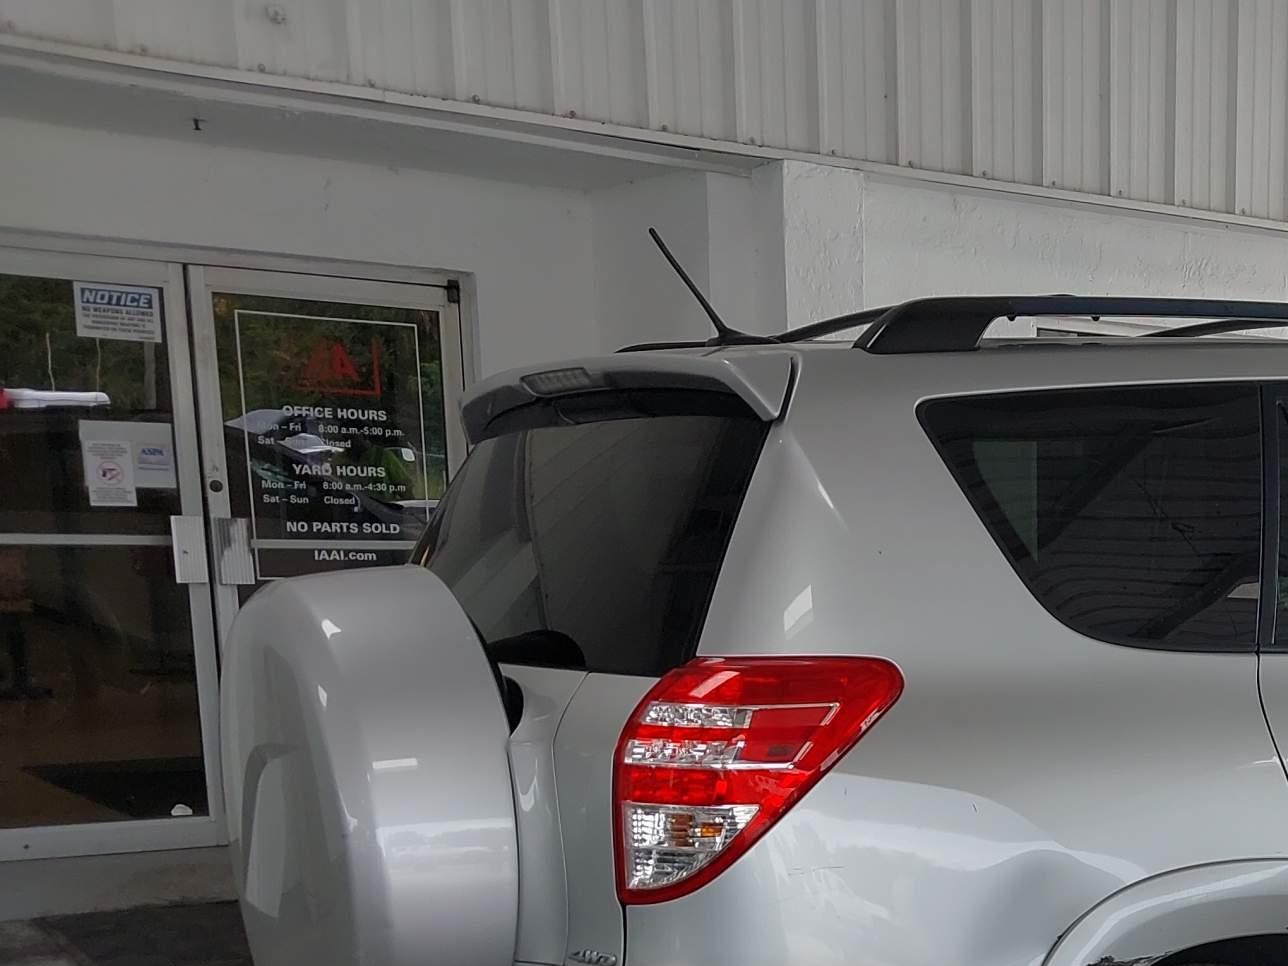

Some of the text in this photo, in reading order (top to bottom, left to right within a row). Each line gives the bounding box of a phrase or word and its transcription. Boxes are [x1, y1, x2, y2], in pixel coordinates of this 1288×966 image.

[83, 289, 151, 307] NOTICE
[282, 405, 388, 421] OFFICE HOURS
[289, 422, 302, 432] Fri
[318, 424, 339, 434] 8:00
[257, 435, 276, 445] Sat
[292, 463, 386, 478] YARD HOURS
[261, 480, 285, 490] Mon
[294, 480, 307, 490] Fri
[323, 481, 343, 491] 8:00
[263, 494, 280, 504] Sat
[290, 494, 309, 505] Sun
[323, 495, 356, 506] Closed
[286, 521, 400, 534] NO PARTS SOLD
[314, 549, 377, 561] IAAI.com
